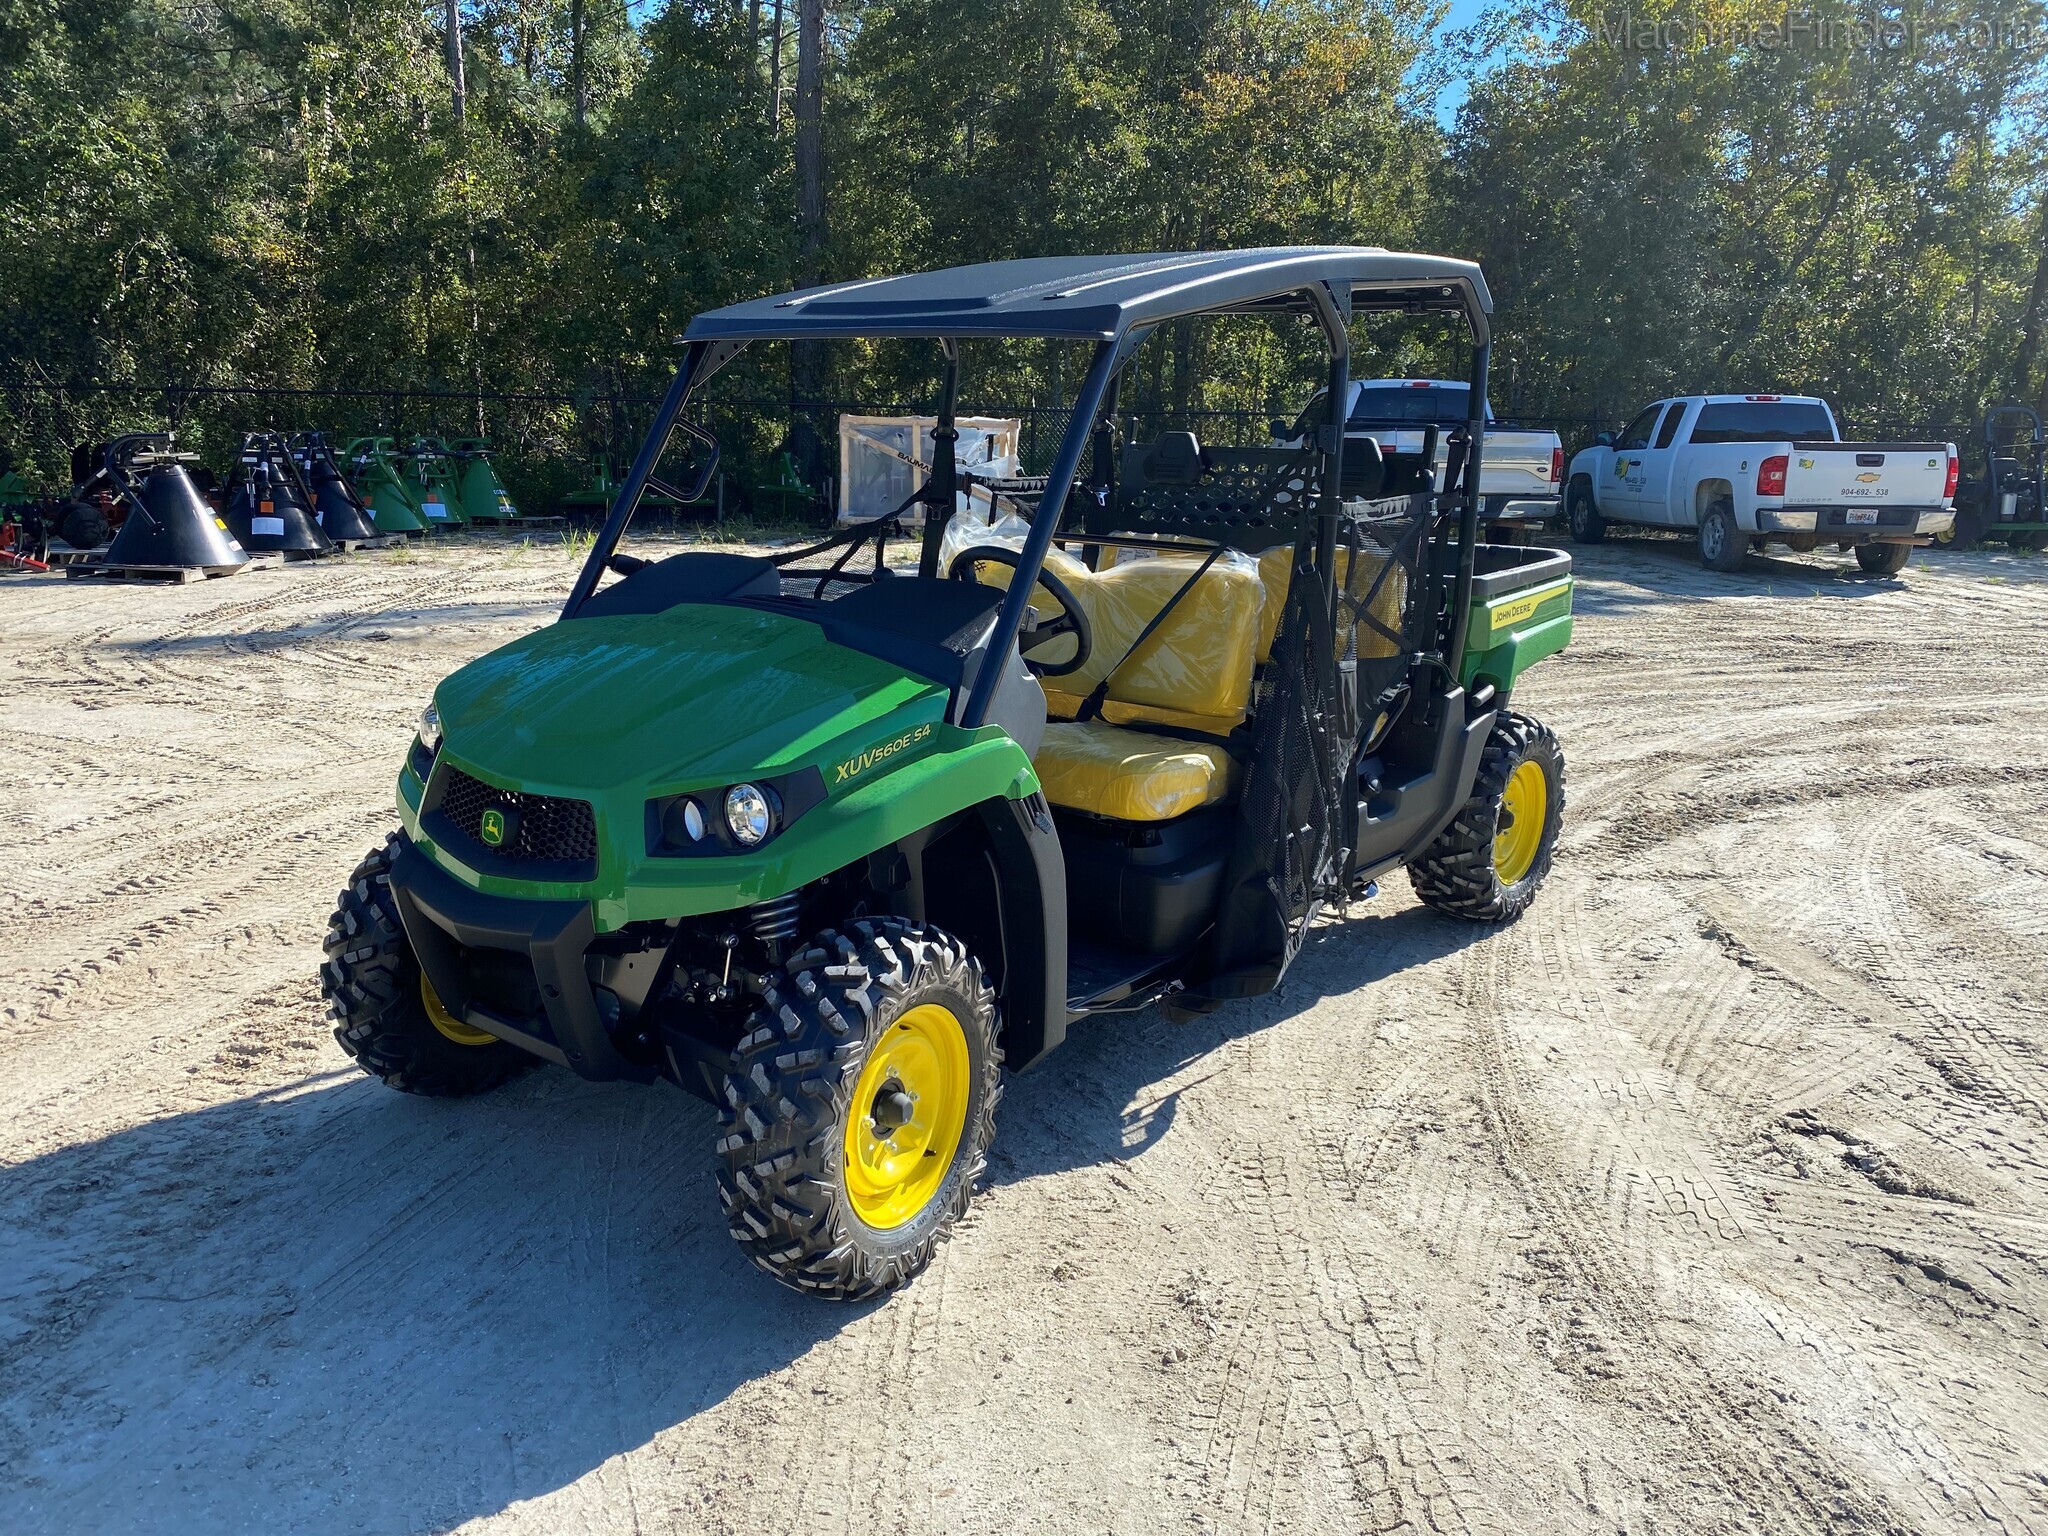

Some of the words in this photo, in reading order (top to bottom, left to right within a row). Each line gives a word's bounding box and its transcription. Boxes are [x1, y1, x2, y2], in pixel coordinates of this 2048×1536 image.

[1495, 611, 1511, 622] JOHN
[1512, 603, 1531, 616] DEERE
[834, 733, 912, 784] XUV560E
[914, 724, 931, 742] S4
